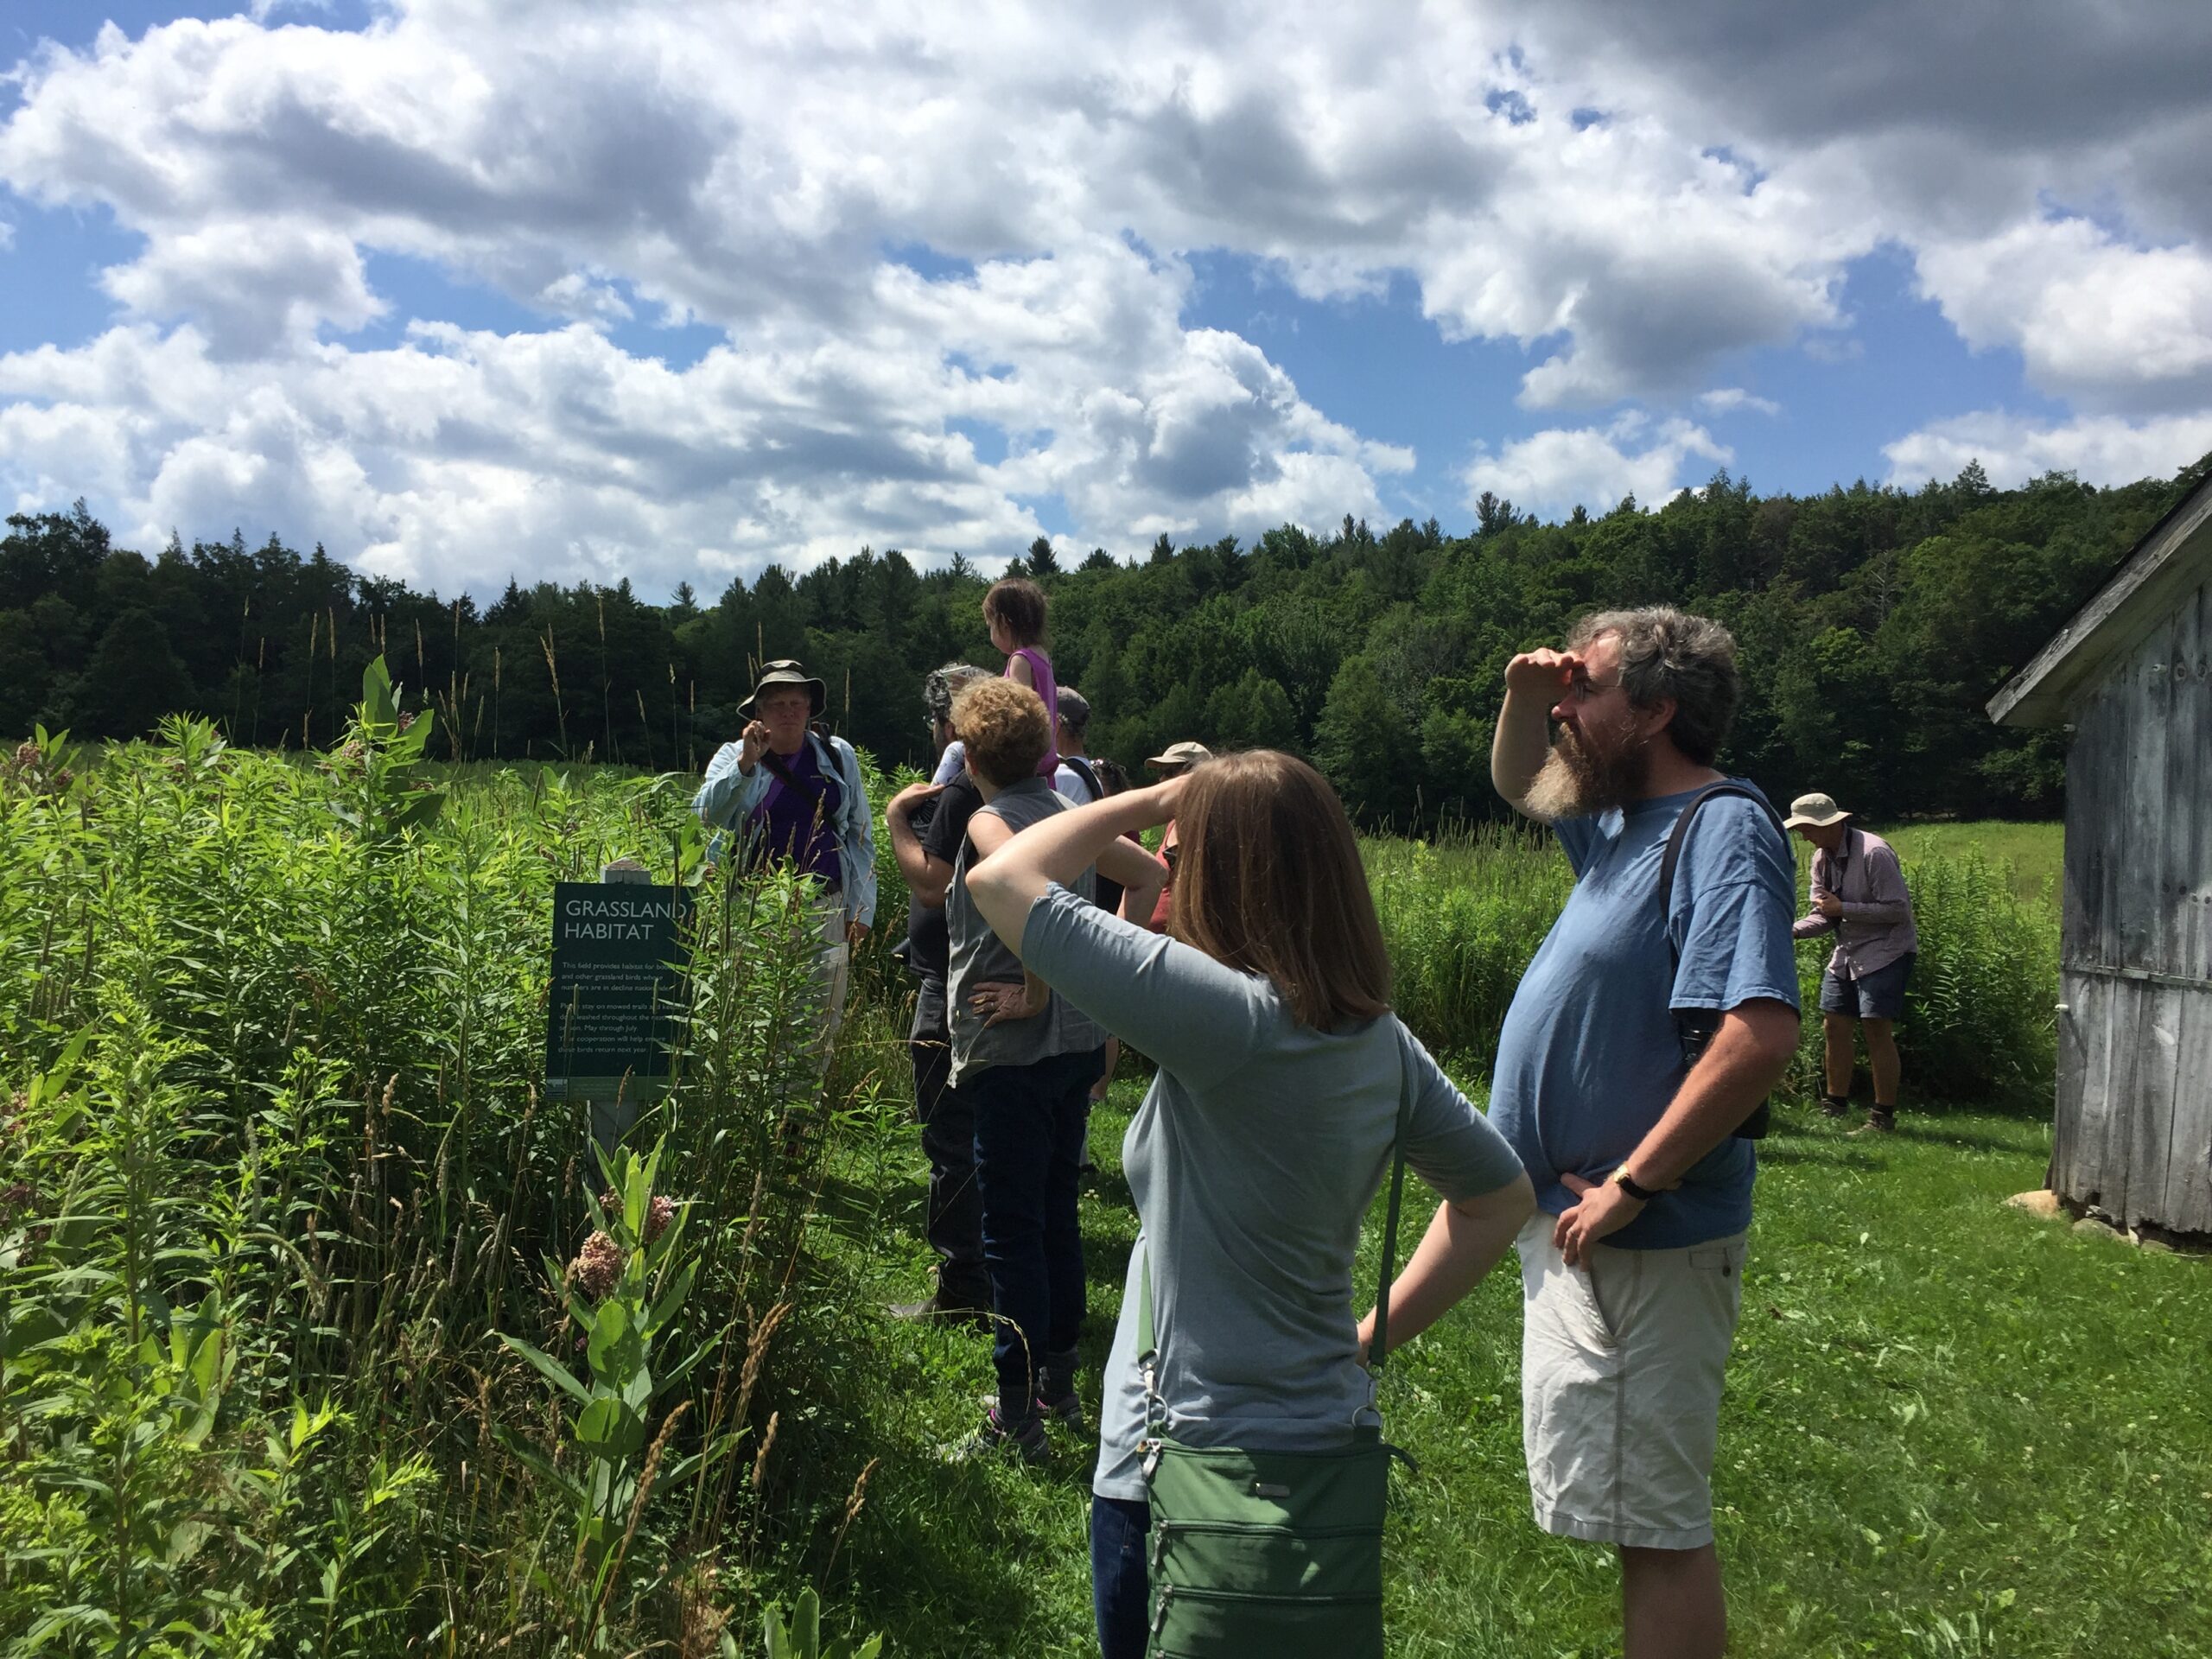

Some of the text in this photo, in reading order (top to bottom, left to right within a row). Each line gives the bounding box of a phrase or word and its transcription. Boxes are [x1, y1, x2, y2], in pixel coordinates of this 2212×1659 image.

[565, 899, 687, 918] GRASSLAND
[564, 922, 655, 940] HABITAT
[593, 962, 620, 970] provides
[601, 1014, 638, 1022] throughout
[584, 1024, 597, 1033] May
